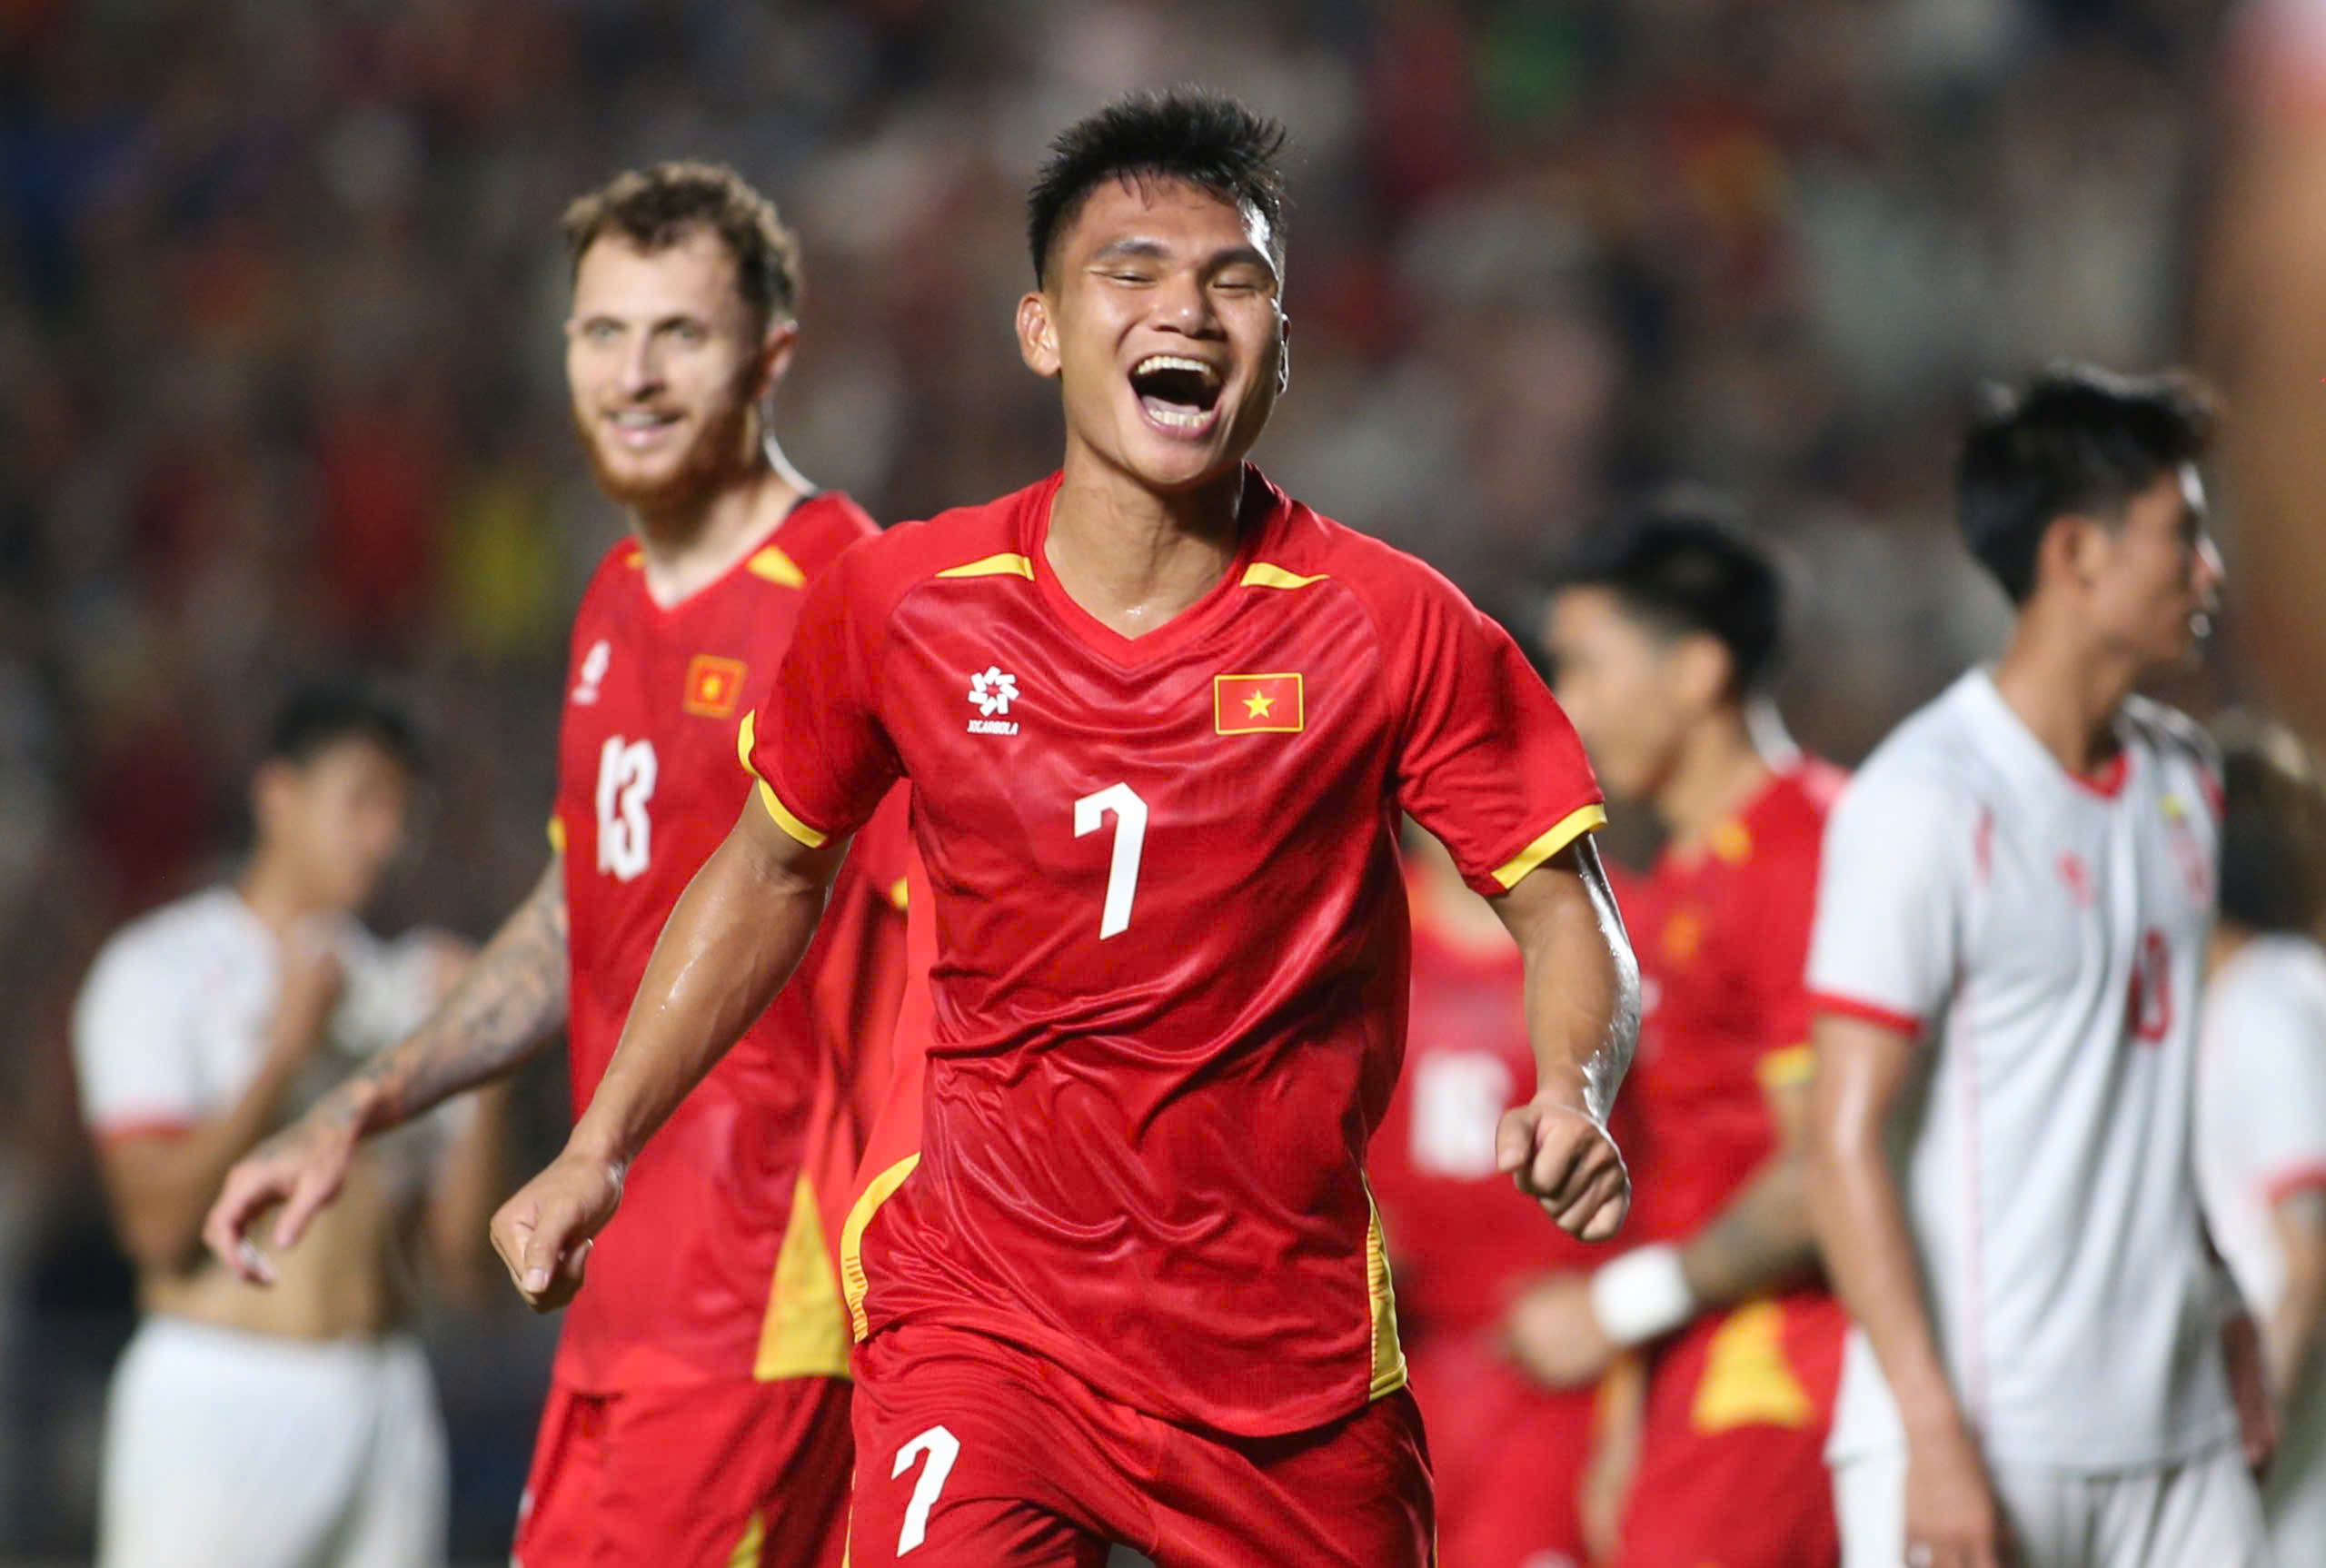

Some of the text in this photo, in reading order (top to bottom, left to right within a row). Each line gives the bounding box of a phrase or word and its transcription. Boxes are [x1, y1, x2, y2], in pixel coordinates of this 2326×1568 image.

[596, 735, 658, 881] 13
[1074, 781, 1148, 940] 7
[890, 1424, 961, 1558] 7
